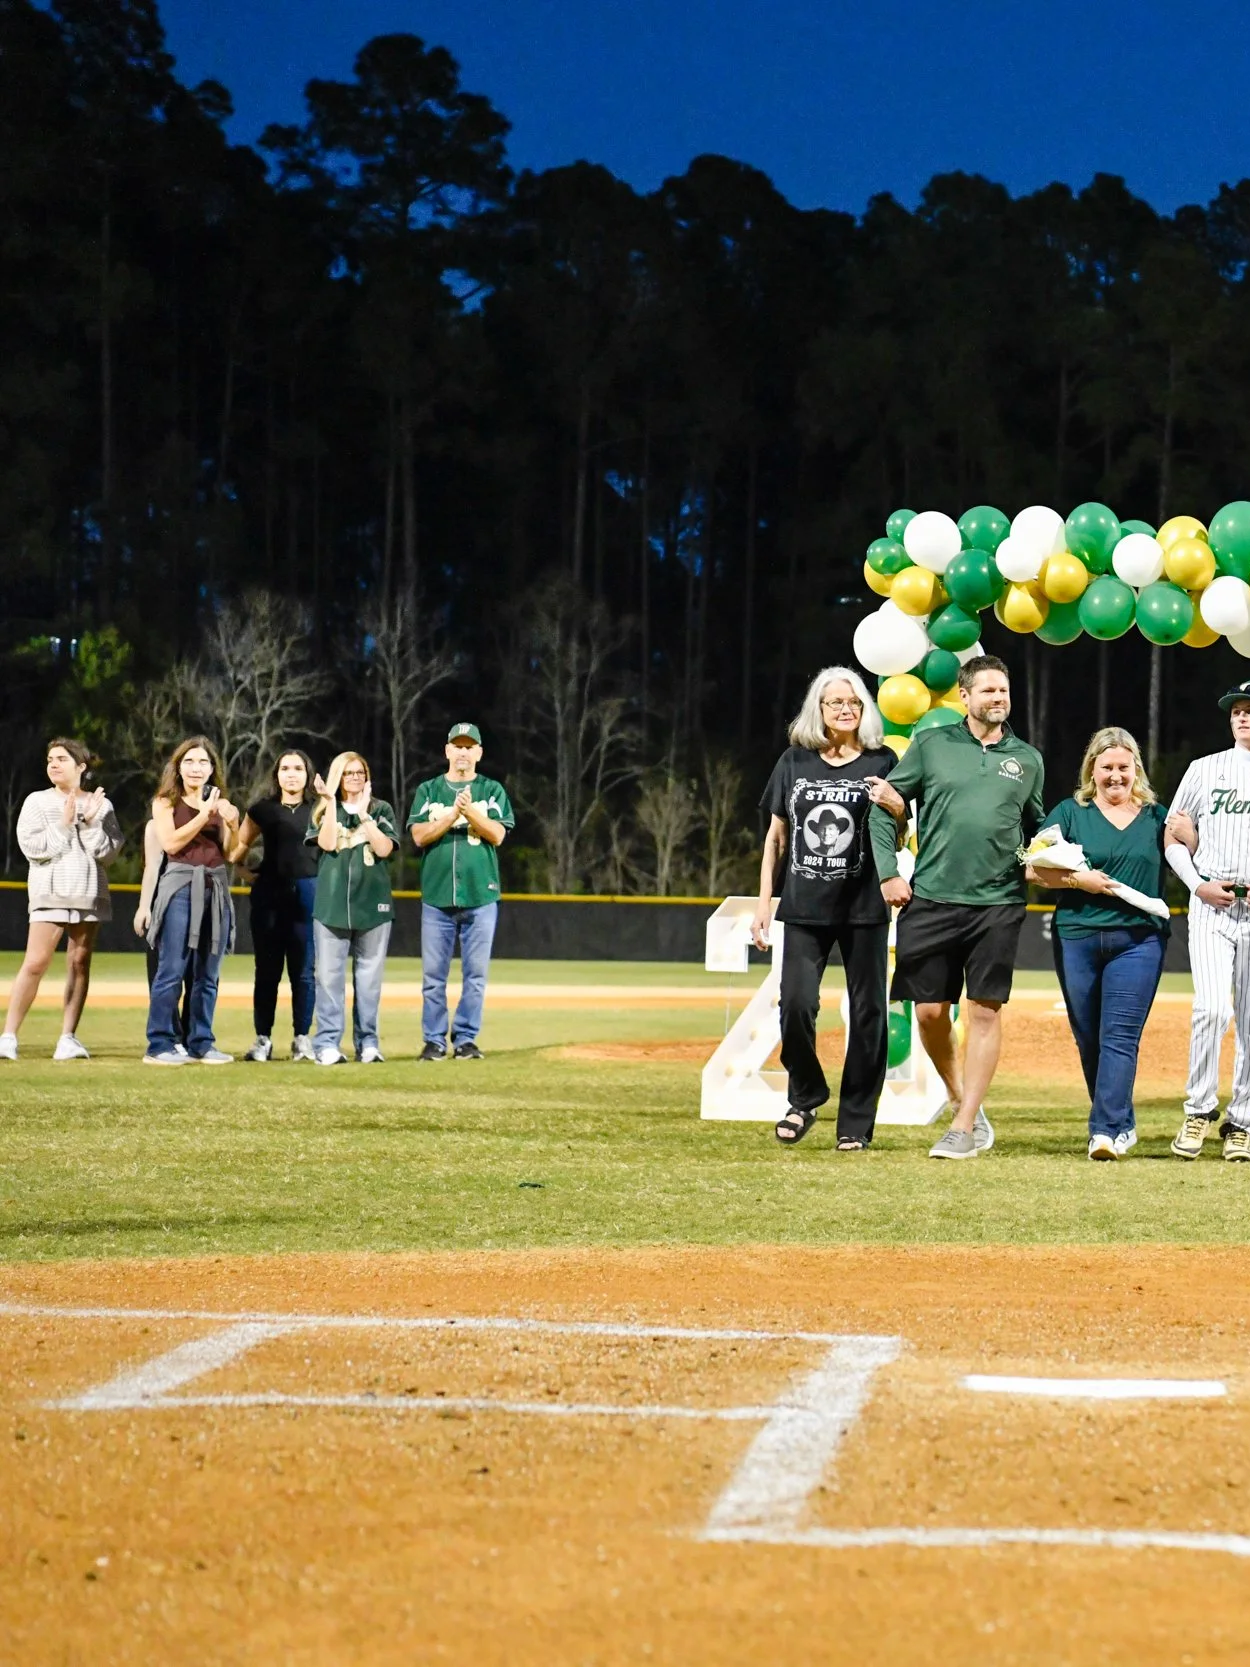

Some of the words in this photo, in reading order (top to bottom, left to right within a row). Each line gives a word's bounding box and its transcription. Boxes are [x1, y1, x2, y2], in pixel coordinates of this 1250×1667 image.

[805, 790, 861, 803] STRAIT
[803, 855, 823, 867] 2024
[826, 857, 847, 868] TOUR
